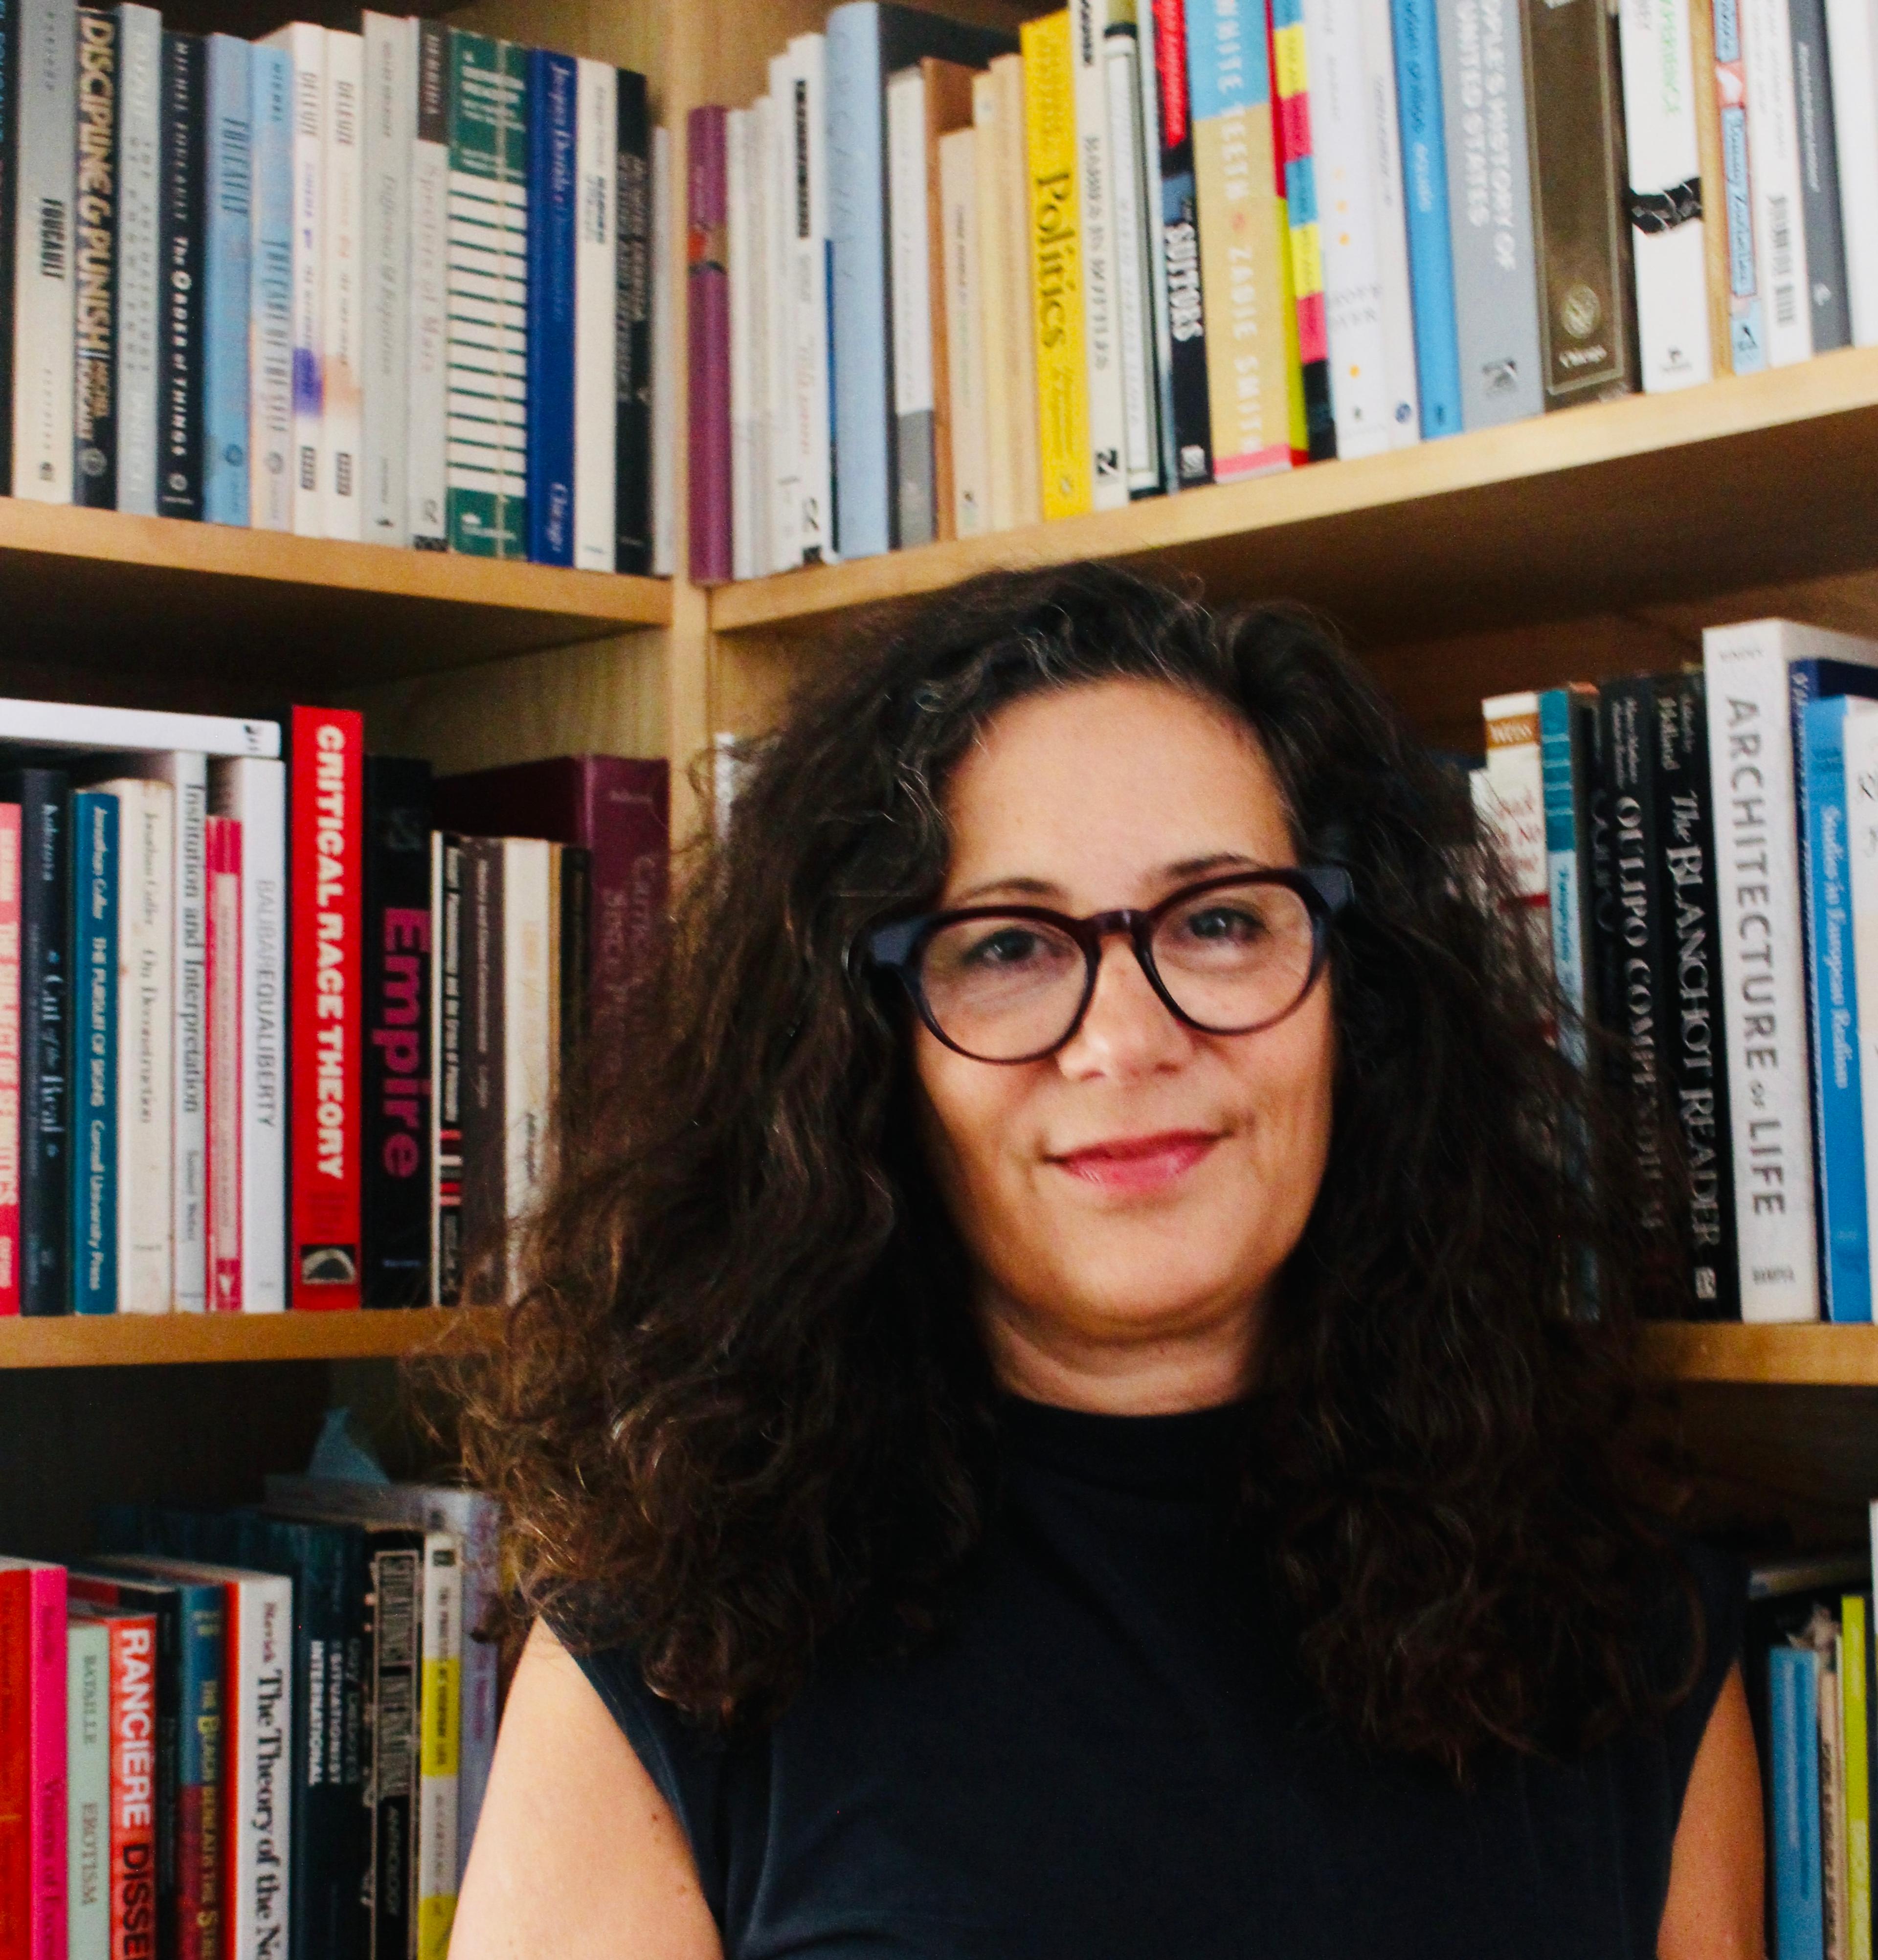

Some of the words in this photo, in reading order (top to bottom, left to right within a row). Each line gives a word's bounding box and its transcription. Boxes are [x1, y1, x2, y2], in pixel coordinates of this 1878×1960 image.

[77, 18, 115, 195] DISCIPLINE
[40, 198, 67, 280] FOUCAULT
[77, 196, 116, 225] &
[1036, 171, 1076, 348] Politics
[78, 226, 111, 352] PUNISH
[172, 270, 193, 346] ORDER
[1163, 222, 1204, 341] SUITORS
[172, 378, 188, 457] THINGS
[183, 783, 203, 898] Institution
[315, 724, 345, 907] CRITICAL
[1615, 796, 1650, 948] OULIPO
[1671, 789, 1700, 844] The
[183, 908, 203, 948] and
[1726, 696, 1780, 1071] ARCHITECTURE
[316, 913, 345, 1019] RACE
[1665, 846, 1714, 1078] BLANCHOT
[179, 959, 203, 1114] Interpretation
[372, 907, 431, 1178] Empire
[315, 1025, 345, 1179] THEORY
[1677, 1087, 1721, 1247] READER
[1748, 1117, 1787, 1217] LIFE
[121, 1627, 151, 1829] RANCIERE
[257, 1668, 283, 1727] The
[308, 1640, 324, 1786] INTERNATIONAL
[251, 1728, 283, 1833] Theory
[80, 1802, 98, 1905] EROTISM
[255, 1873, 281, 1921] the
[256, 1838, 282, 1869] of
